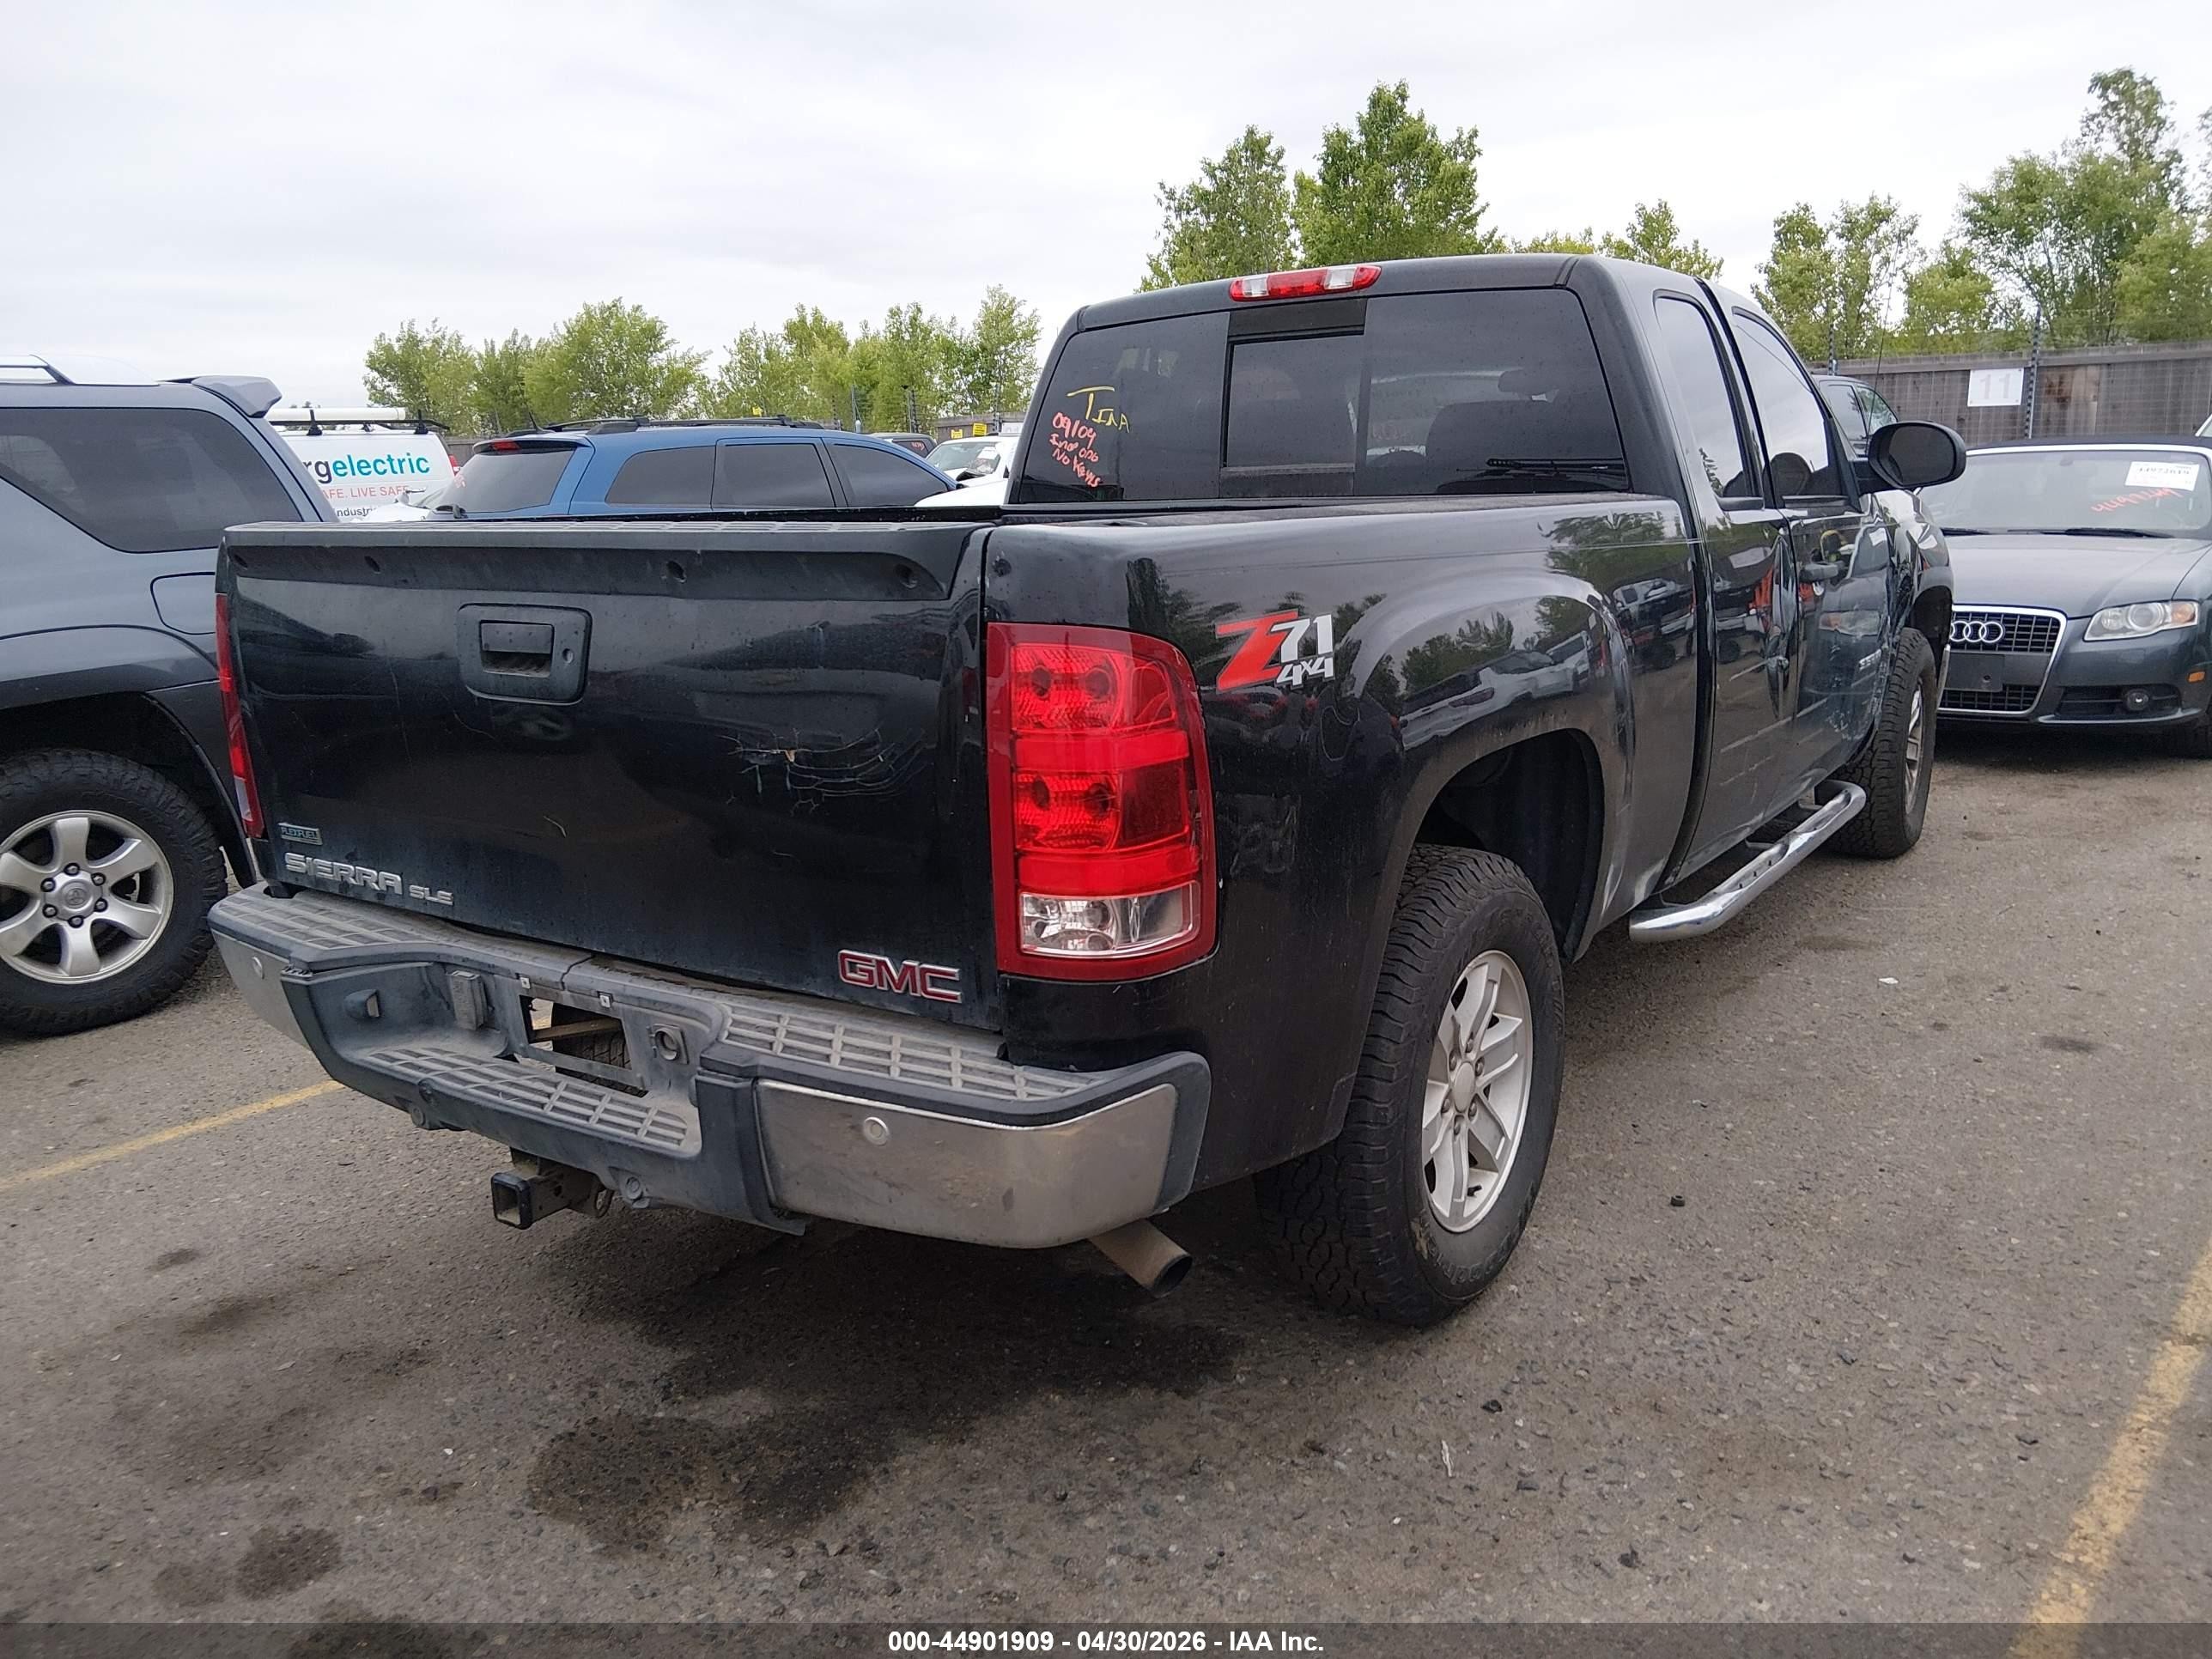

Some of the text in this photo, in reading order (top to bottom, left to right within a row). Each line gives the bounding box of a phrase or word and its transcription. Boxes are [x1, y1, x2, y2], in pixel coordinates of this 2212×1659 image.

[350, 487, 377, 498] LIVE
[284, 852, 454, 906] SIERRA SLE
[838, 949, 963, 1004] GMC
